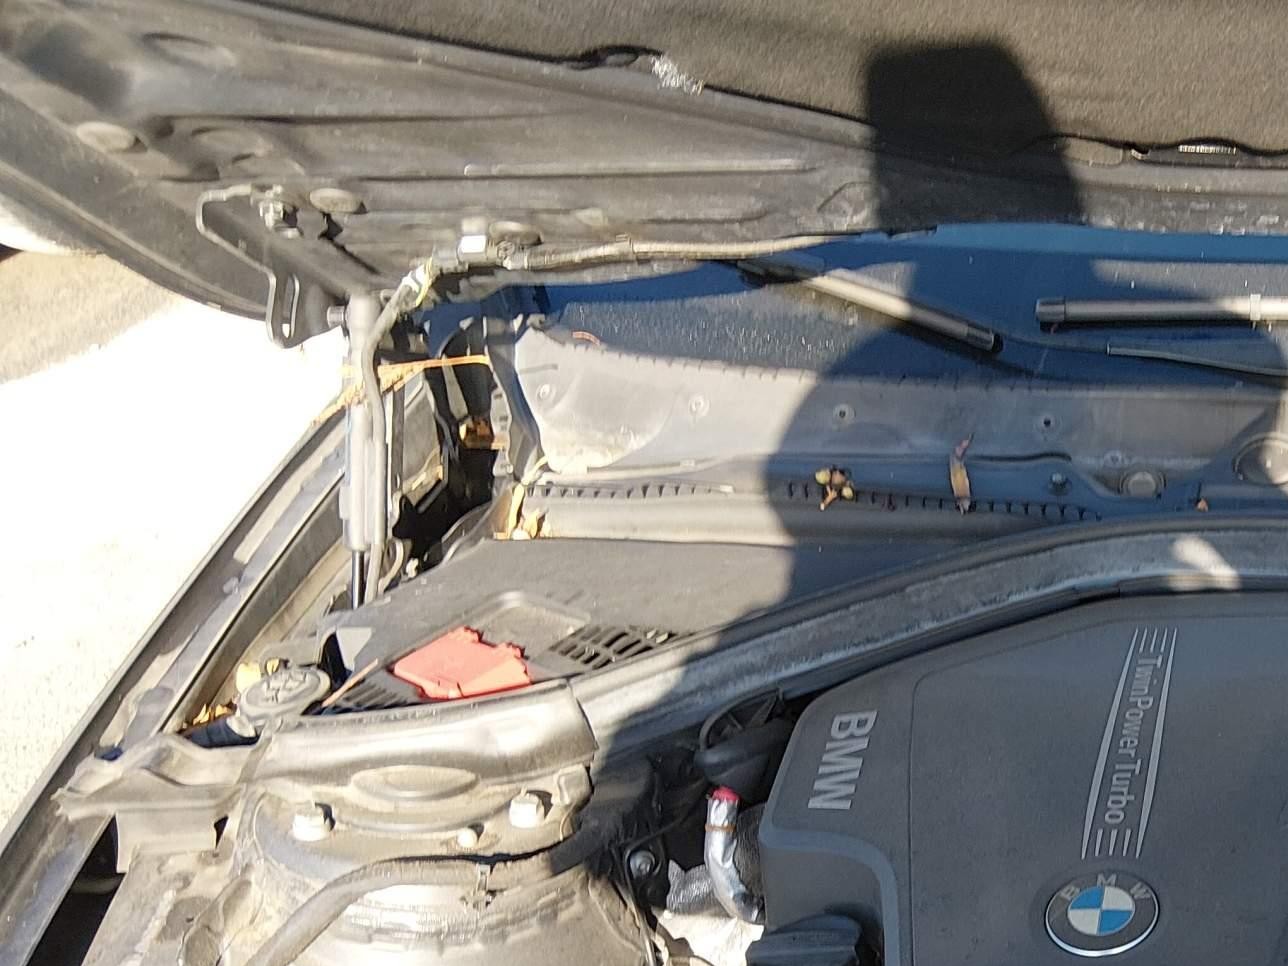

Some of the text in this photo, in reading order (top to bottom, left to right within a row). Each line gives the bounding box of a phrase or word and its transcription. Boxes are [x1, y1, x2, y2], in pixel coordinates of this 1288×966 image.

[807, 709, 878, 810] BMW
[1104, 655, 1163, 825] TwinPower Turbo
[1059, 873, 1152, 901] BMW
